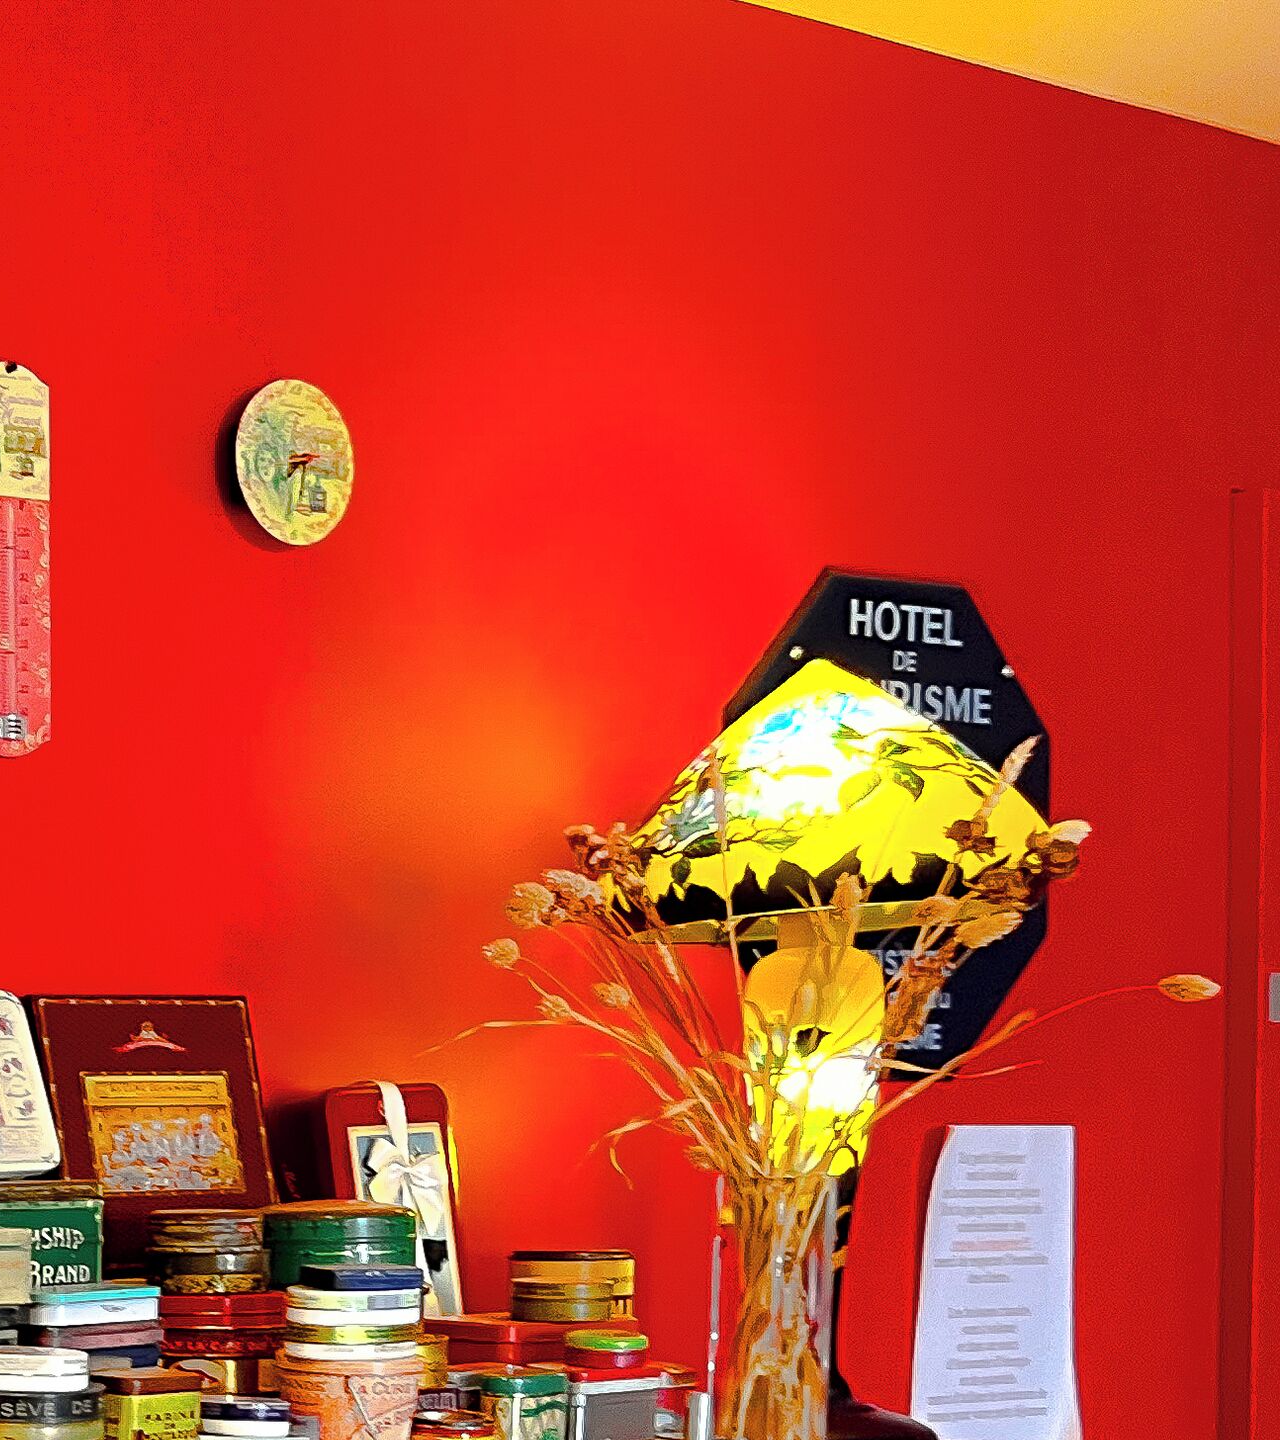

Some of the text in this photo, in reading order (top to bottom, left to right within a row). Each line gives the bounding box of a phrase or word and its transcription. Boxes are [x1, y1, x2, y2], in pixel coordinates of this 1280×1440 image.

[848, 597, 964, 648] HOTEL
[892, 650, 918, 673] DE
[31, 1261, 91, 1288] BRAND
[71, 1399, 93, 1415] DE
